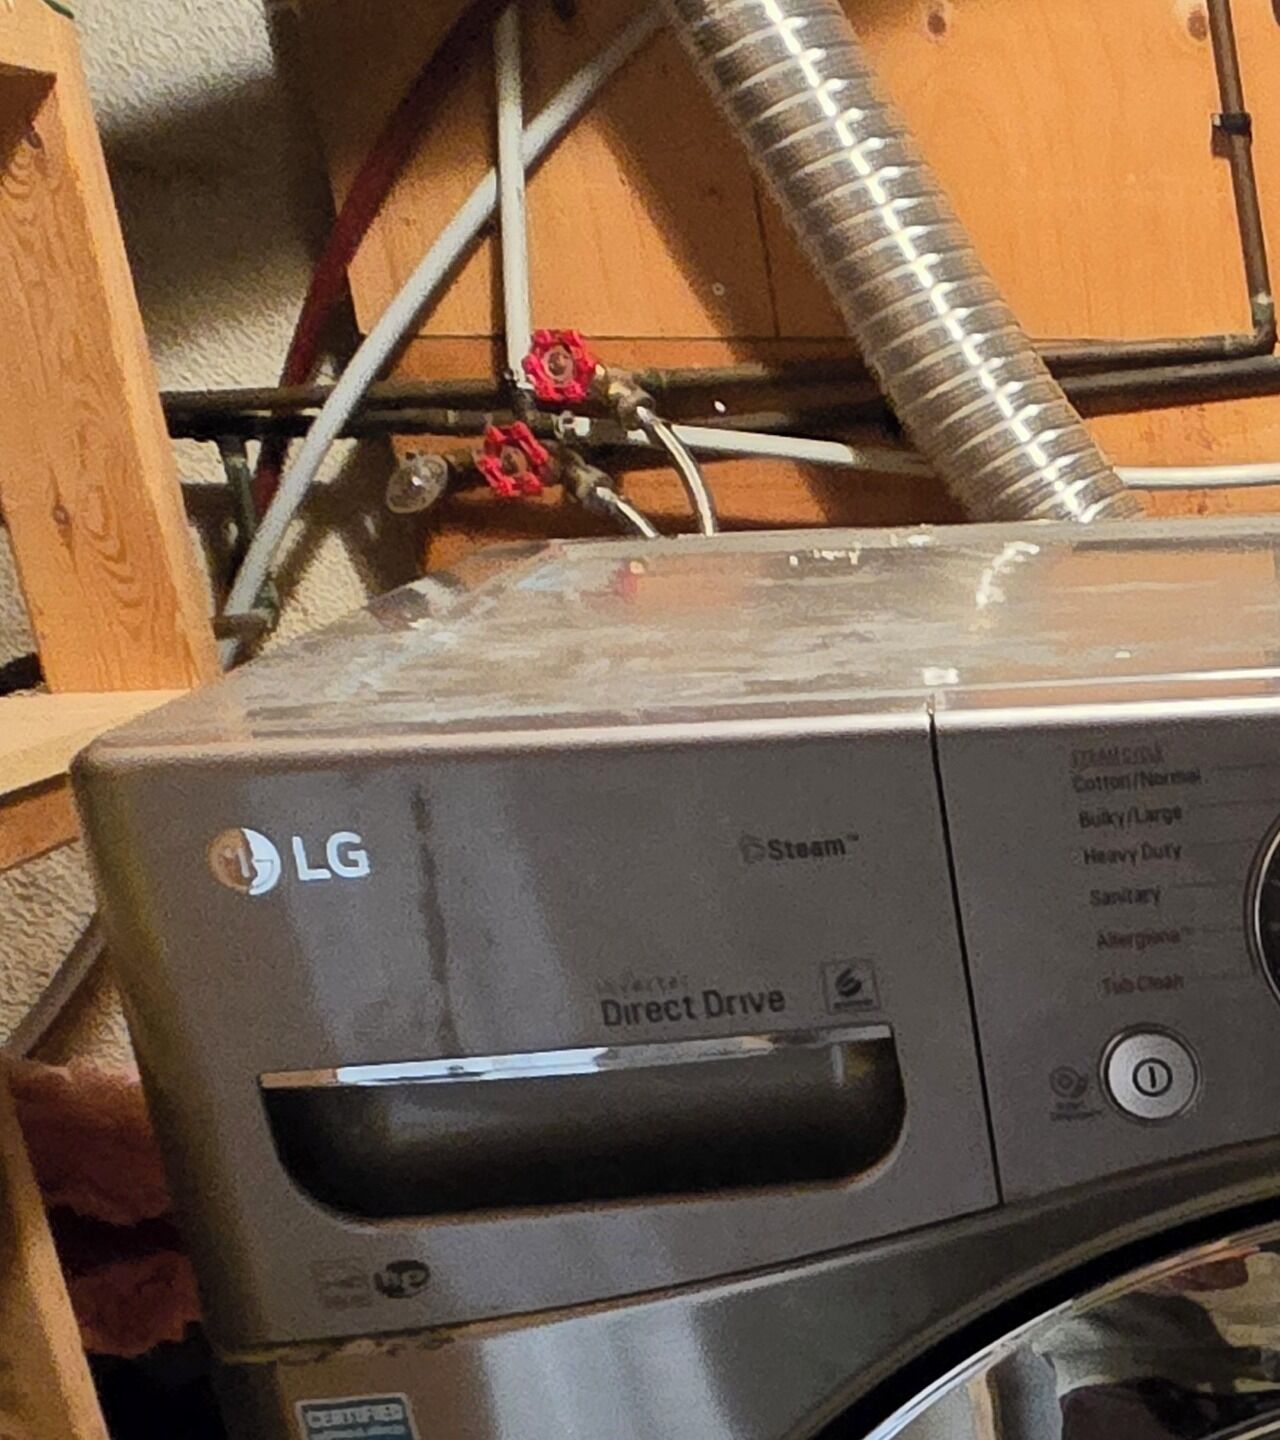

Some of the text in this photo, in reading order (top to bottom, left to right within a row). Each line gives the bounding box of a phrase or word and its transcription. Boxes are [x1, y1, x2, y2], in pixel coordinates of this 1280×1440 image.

[292, 831, 371, 881] LG
[1084, 842, 1183, 867] Heavy Duty
[602, 987, 787, 1027] Direct Drive
